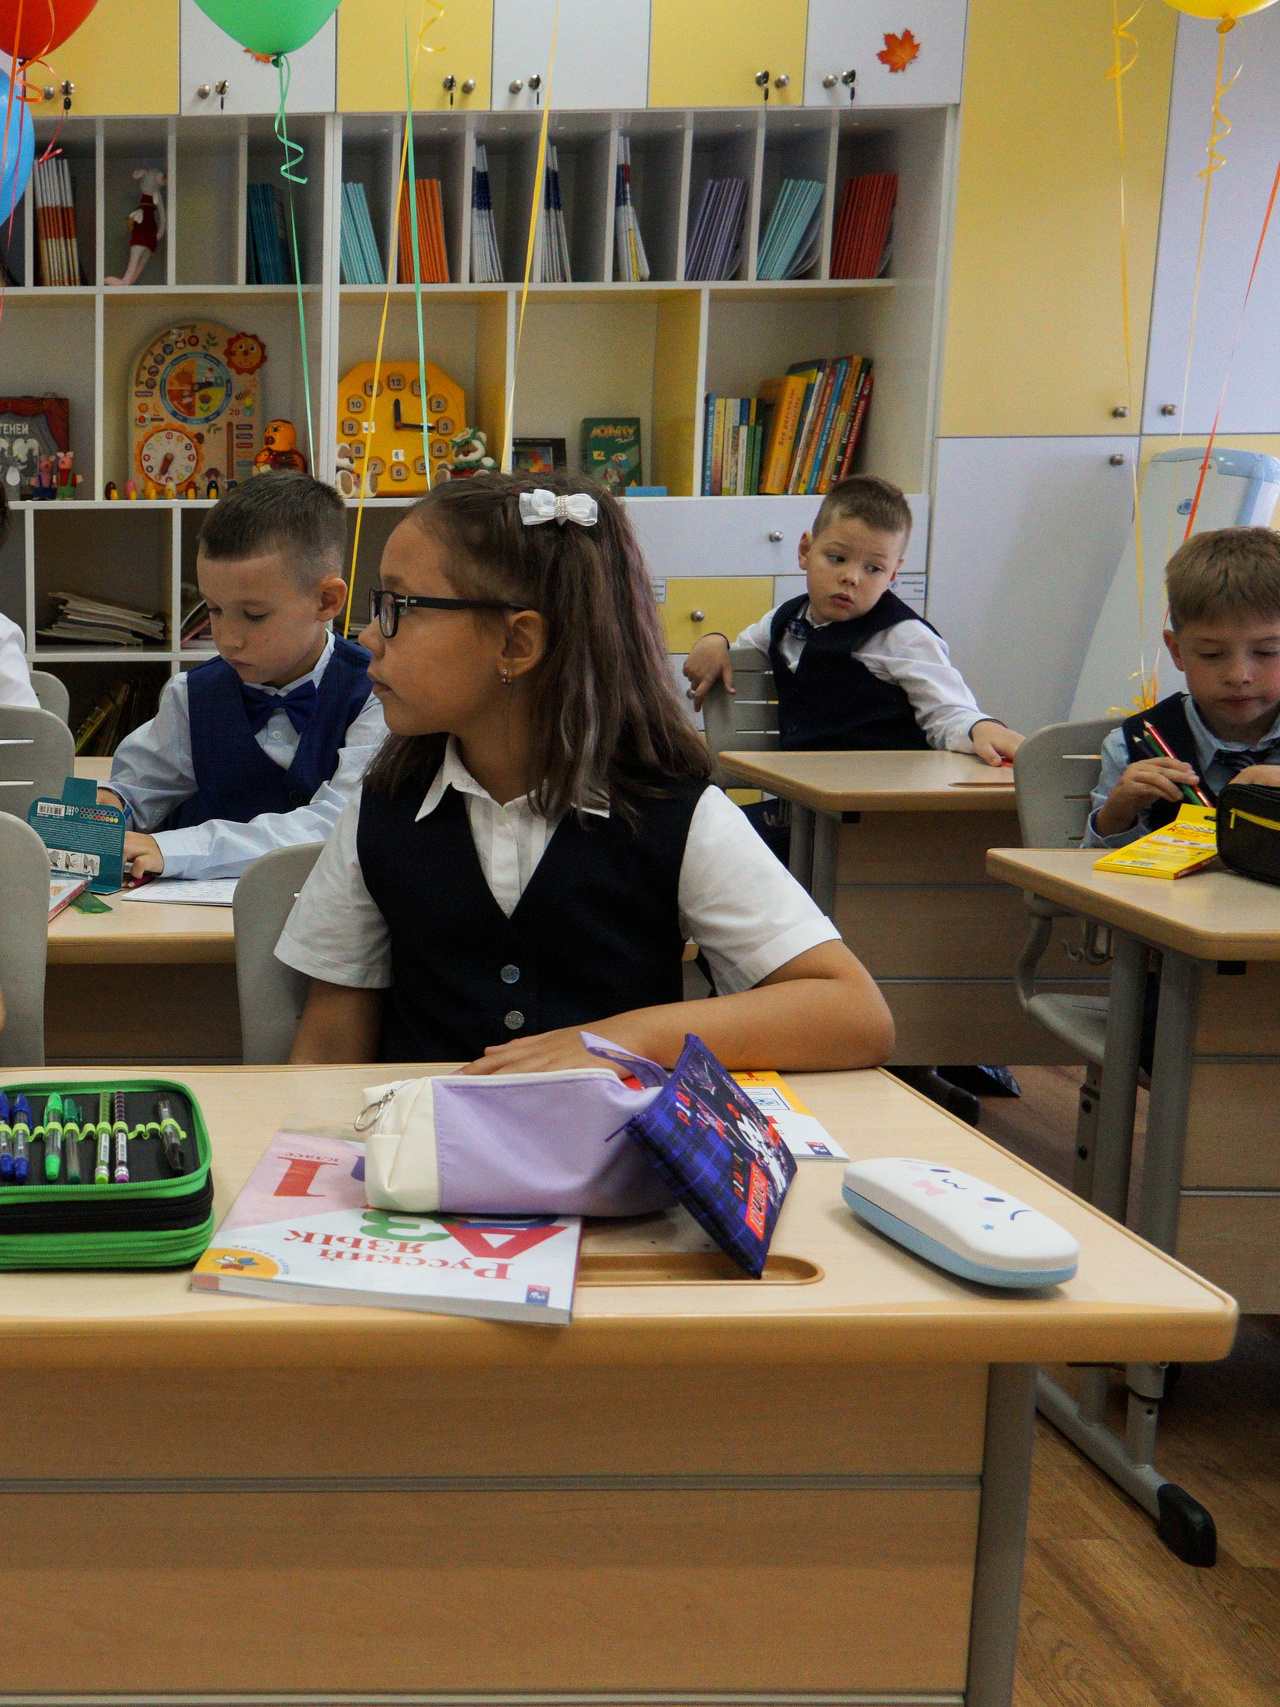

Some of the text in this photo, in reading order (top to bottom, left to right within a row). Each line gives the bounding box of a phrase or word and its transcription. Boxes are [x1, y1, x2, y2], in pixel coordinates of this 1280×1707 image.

[420, 462, 426, 470] 5
[273, 1155, 340, 1198] 1
[282, 1228, 428, 1255] язык
[320, 1247, 515, 1280] Русский
